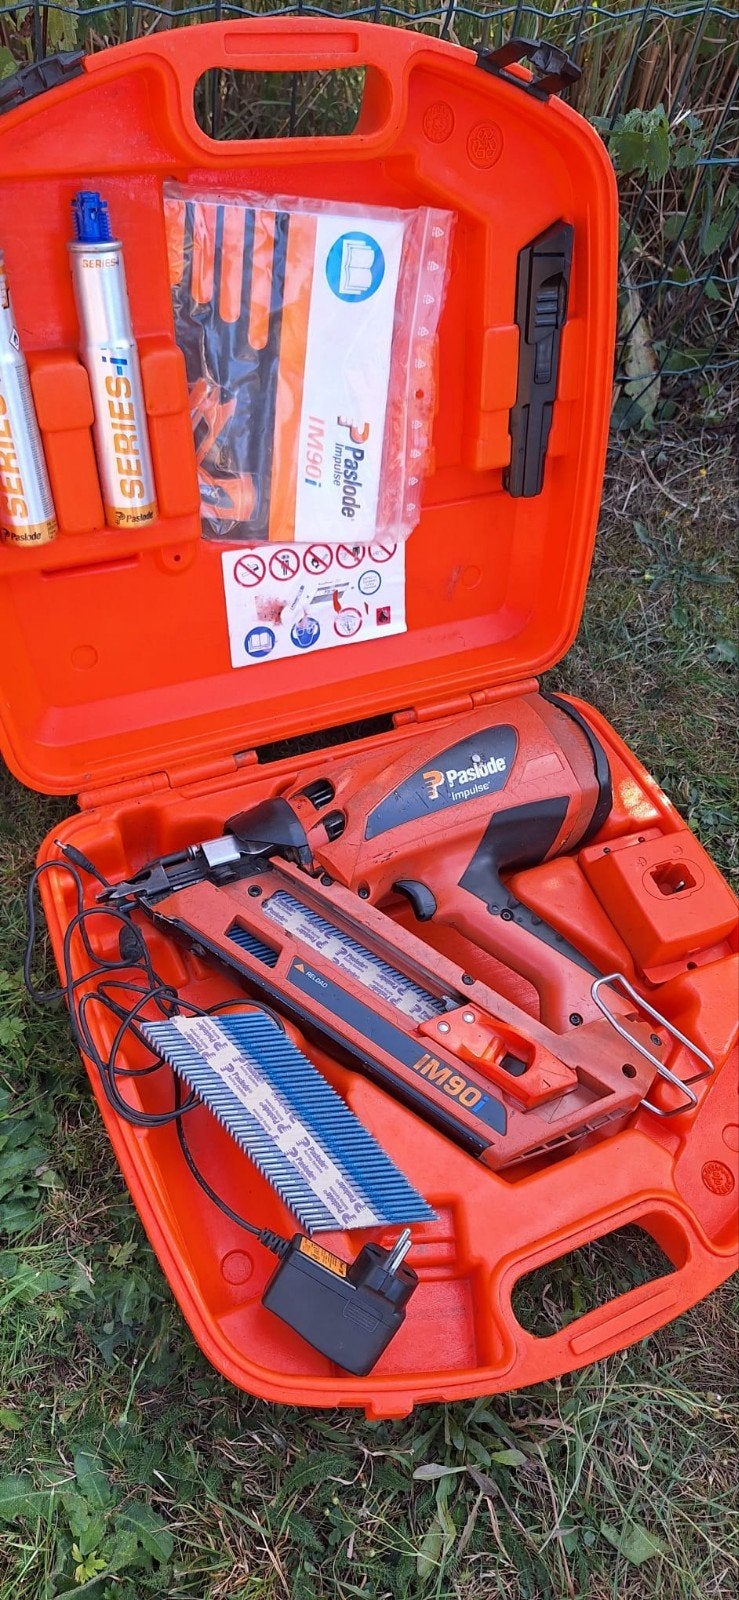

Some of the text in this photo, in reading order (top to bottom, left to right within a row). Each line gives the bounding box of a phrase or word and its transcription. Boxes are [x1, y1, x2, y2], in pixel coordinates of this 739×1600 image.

[102, 355, 146, 500] SERIES-i
[304, 416, 325, 488] IM90i
[332, 443, 342, 487] Impulse
[341, 445, 365, 519] Paslode
[126, 510, 154, 523] Paslode
[11, 531, 42, 542] Paslode
[446, 756, 507, 788] Paslode
[451, 781, 490, 802] Impulse
[232, 1071, 250, 1092] Paslode
[413, 1054, 490, 1114] IM90i
[260, 1103, 279, 1124] Paslode
[295, 1156, 315, 1178] Paslode
[307, 1146, 327, 1167] Paslode
[324, 1191, 344, 1214] Paslode
